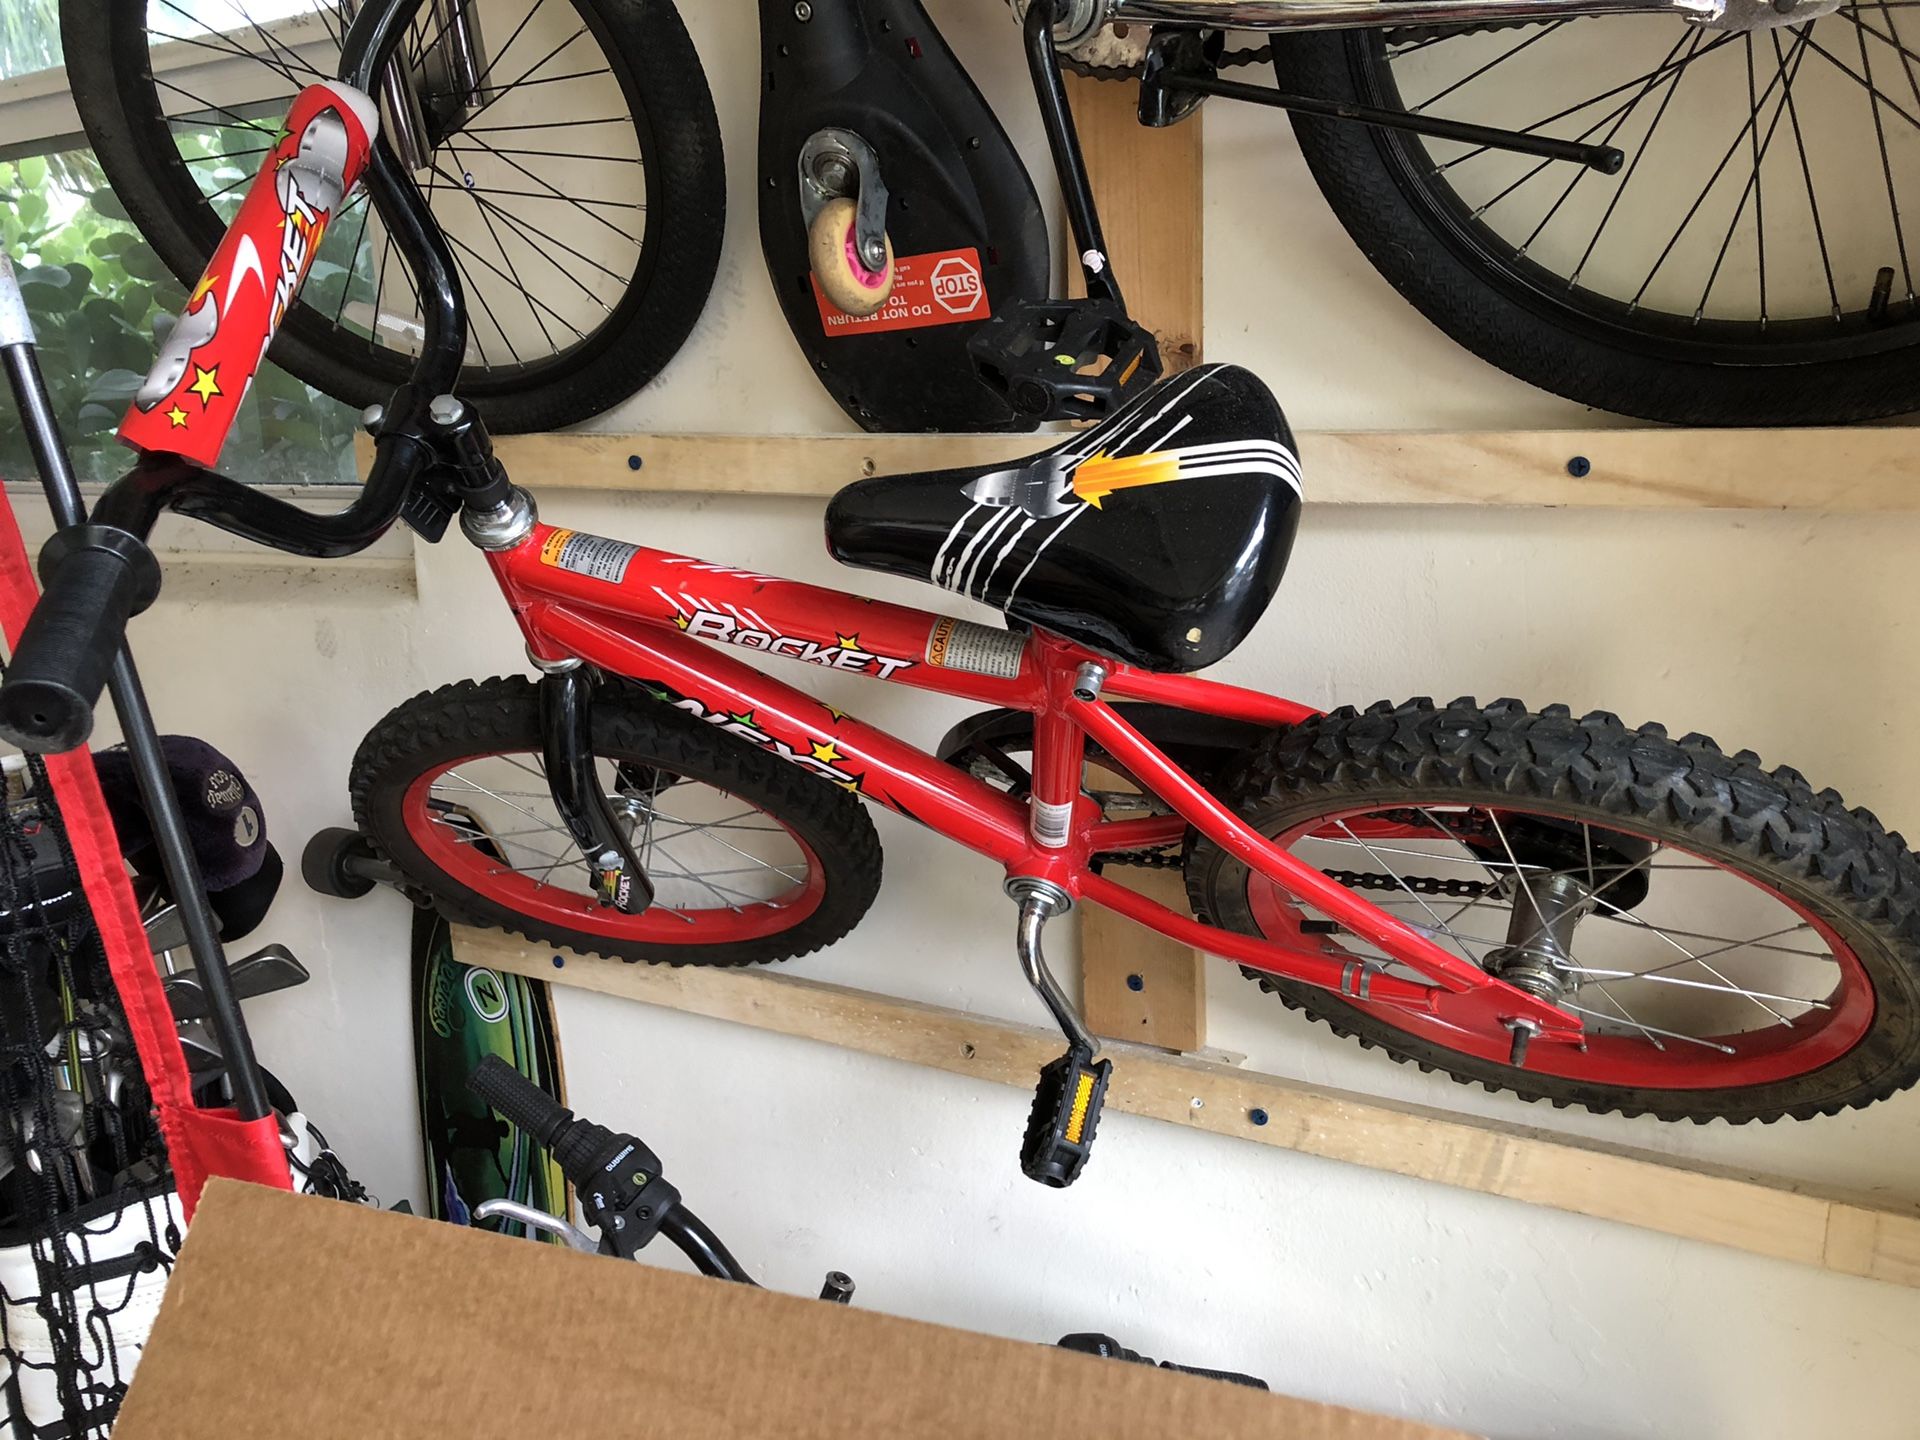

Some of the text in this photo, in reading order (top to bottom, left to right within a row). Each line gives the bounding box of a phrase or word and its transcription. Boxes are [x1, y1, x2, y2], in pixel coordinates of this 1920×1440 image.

[936, 275, 979, 296] STOP
[889, 295, 908, 306] TO
[912, 304, 932, 316] DO
[882, 307, 908, 320] NOT
[685, 608, 915, 679] ROCKET
[209, 769, 229, 789] GOLF
[615, 875, 631, 910] ROCKET
[605, 1144, 635, 1172] SHIMANO
